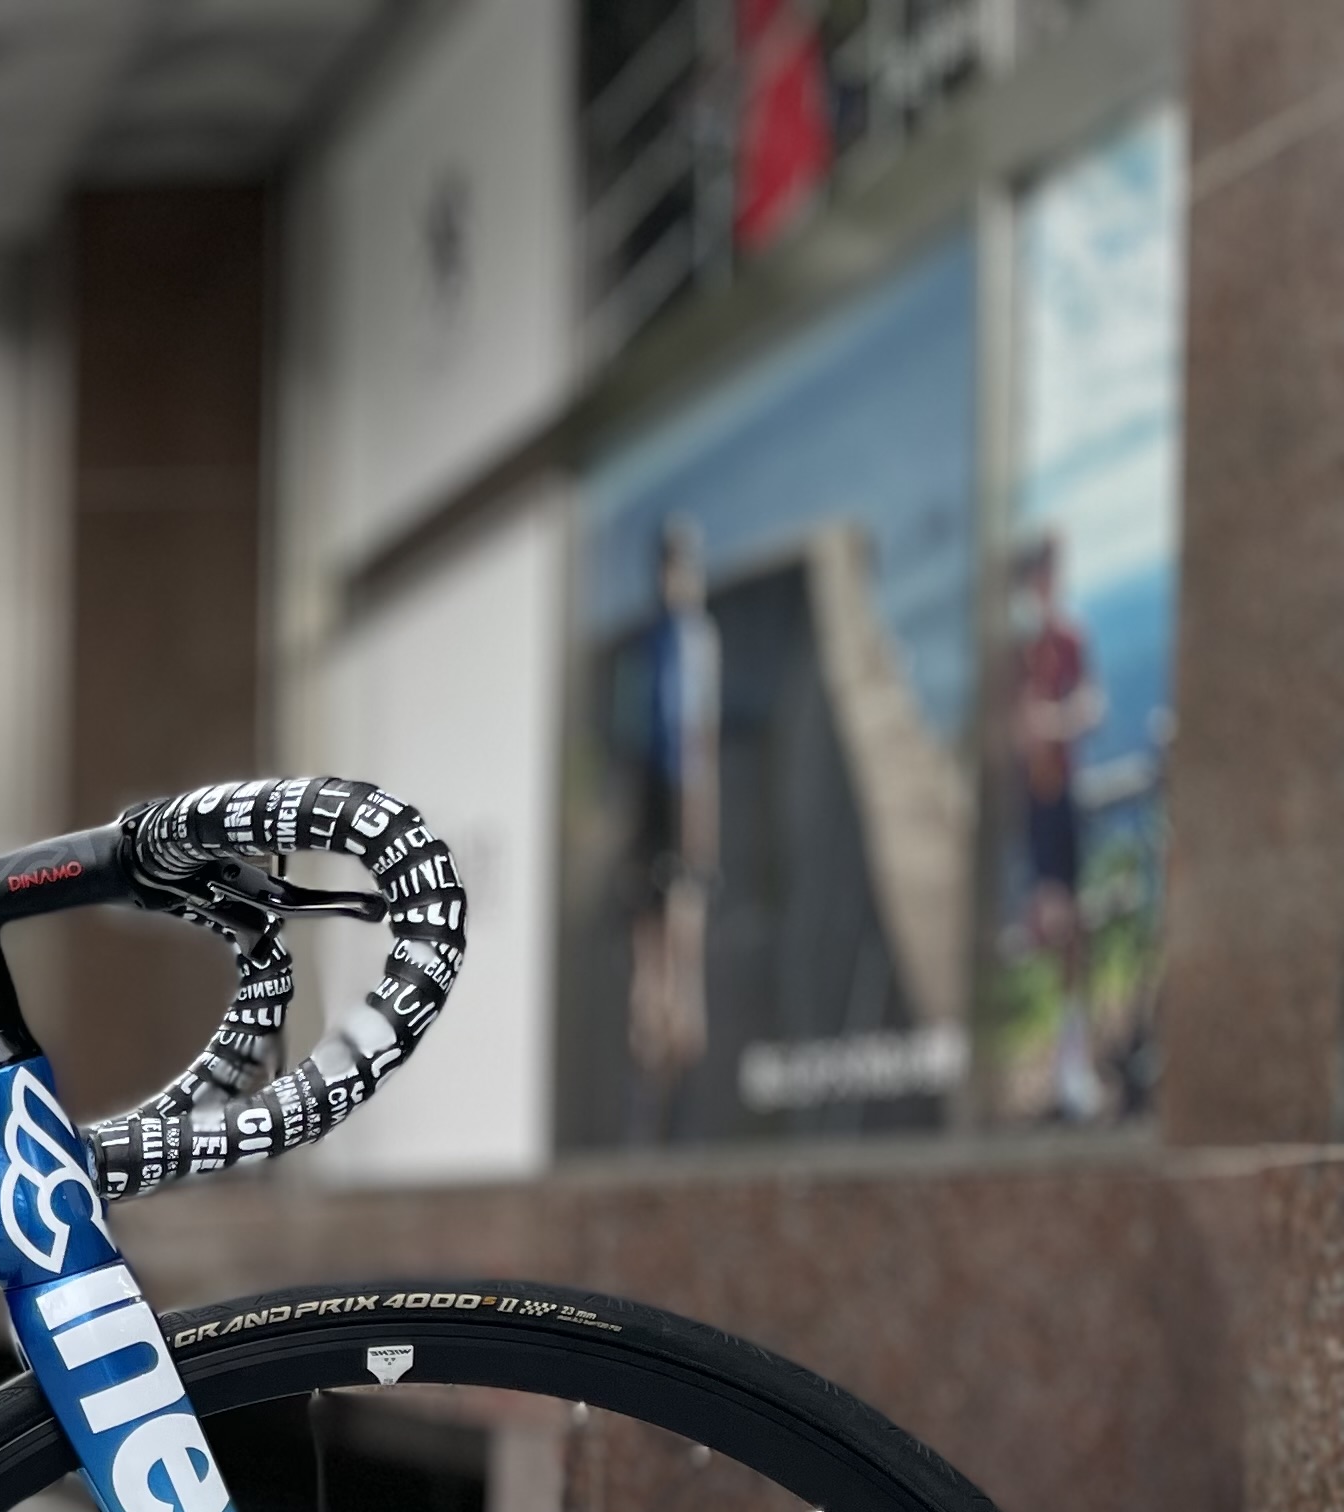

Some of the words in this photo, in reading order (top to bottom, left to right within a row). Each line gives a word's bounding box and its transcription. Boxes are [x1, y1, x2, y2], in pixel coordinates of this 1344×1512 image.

[8, 860, 83, 892] DINAMO
[393, 939, 454, 994] CELLI
[237, 975, 293, 1001] CINELLI
[368, 1347, 412, 1357] MICHE
